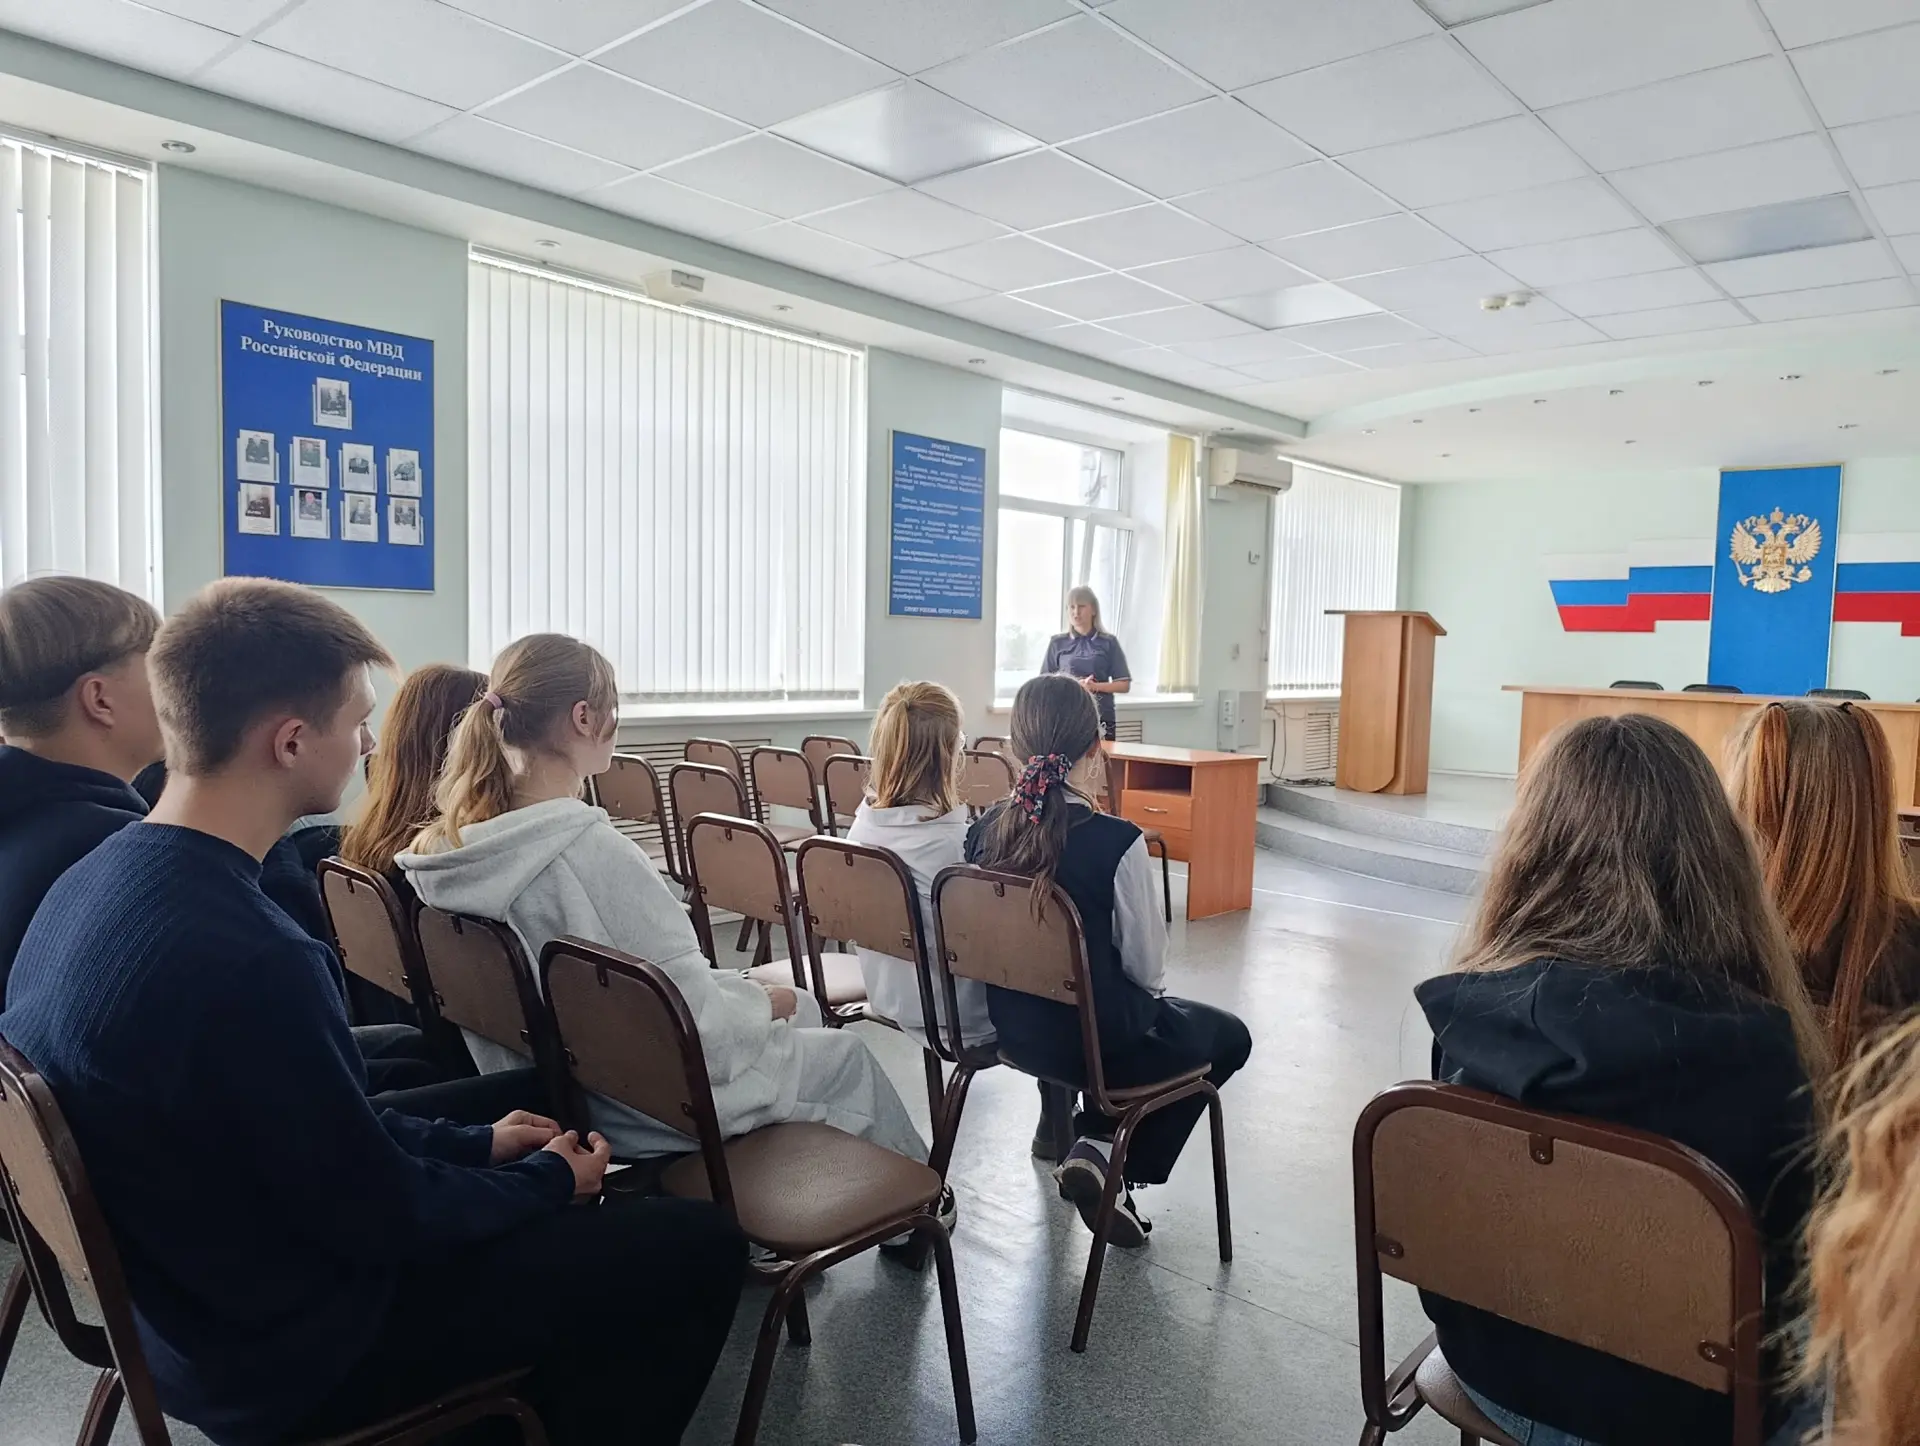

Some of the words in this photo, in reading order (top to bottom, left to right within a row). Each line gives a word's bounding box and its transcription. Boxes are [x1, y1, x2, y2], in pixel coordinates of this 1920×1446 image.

[240, 336, 336, 366] Российской
[339, 354, 422, 381] Федерации
[263, 319, 363, 350] Руководство
[367, 339, 404, 361] МВД
